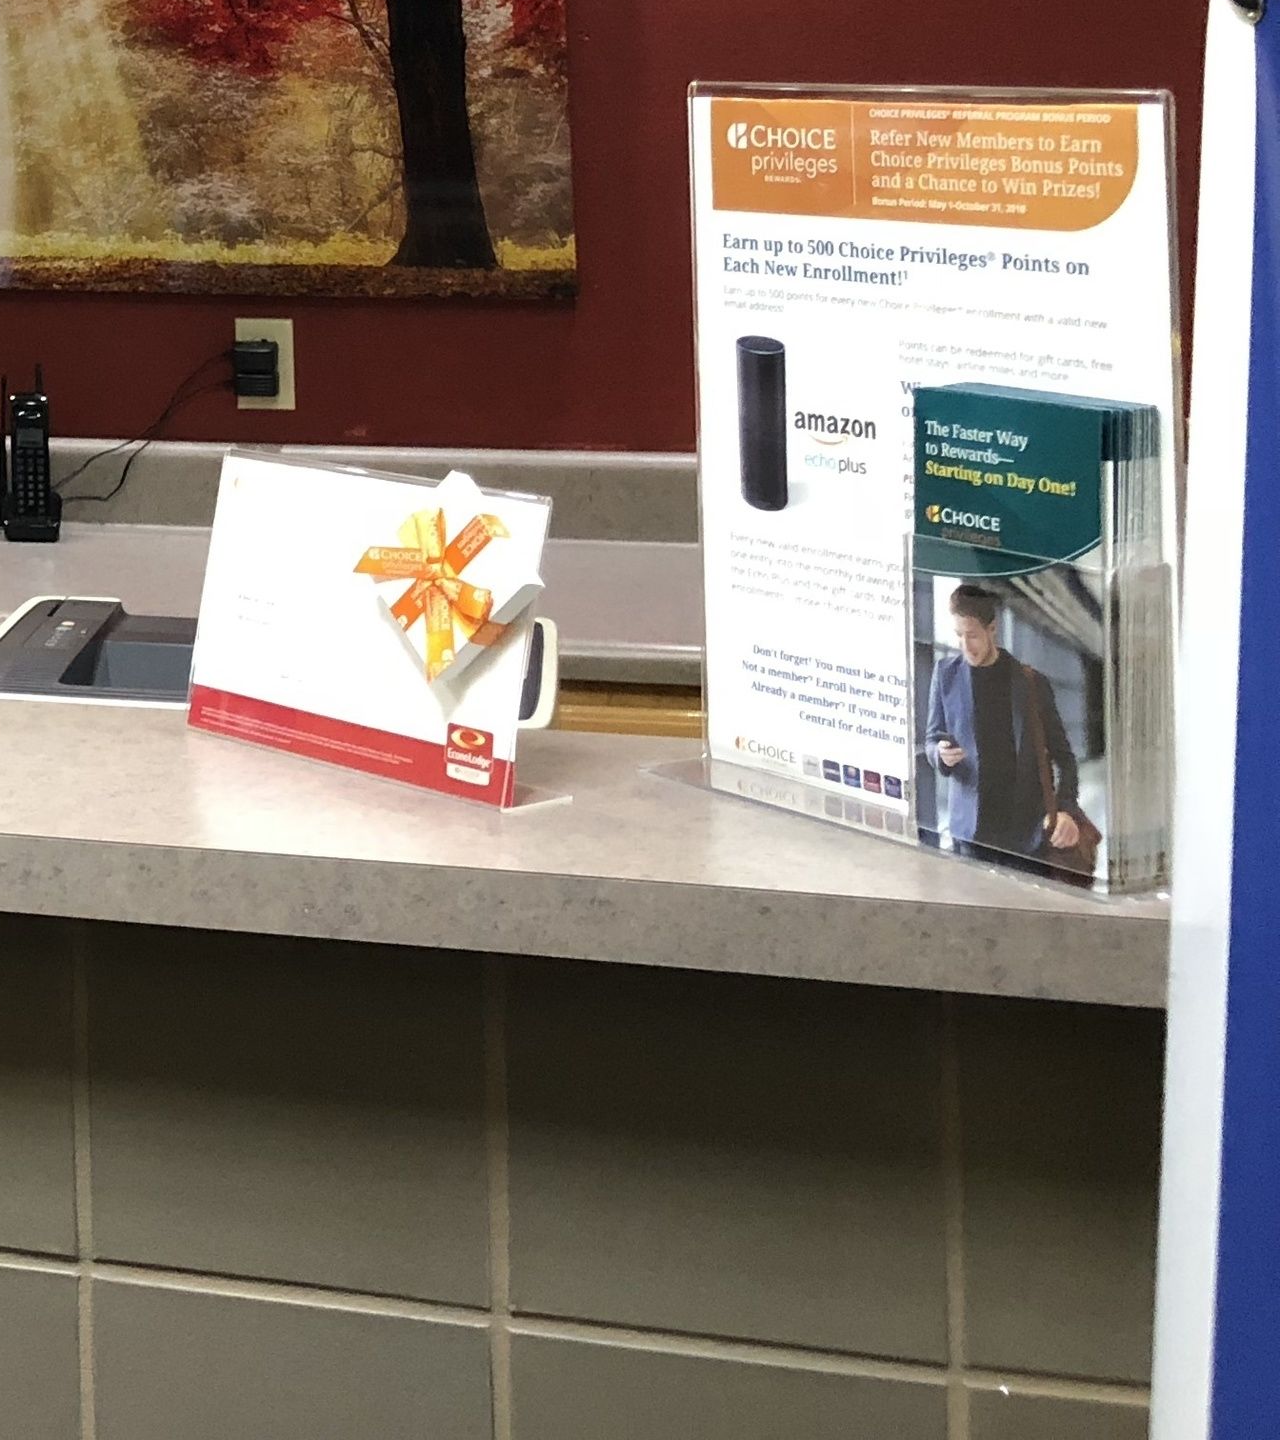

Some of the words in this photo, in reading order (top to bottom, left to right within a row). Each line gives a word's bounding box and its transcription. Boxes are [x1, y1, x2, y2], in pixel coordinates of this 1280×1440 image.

[1076, 113, 1111, 124] PERIOD
[750, 124, 837, 150] CHOICE
[870, 129, 912, 147] Refer
[916, 130, 951, 148] New
[956, 132, 1034, 151] Members
[1039, 135, 1055, 152] to
[1060, 135, 1102, 153] Earn
[751, 151, 838, 178] privileges
[870, 150, 923, 169] Choice
[926, 152, 1006, 175] Privileges
[1011, 156, 1063, 175] Bonus
[1067, 158, 1124, 177] Points
[871, 172, 901, 188] and
[905, 176, 914, 189] a
[918, 174, 977, 193] Chance
[981, 177, 997, 194] to
[1002, 178, 1037, 196] Win
[1042, 180, 1101, 199] Prizes!
[871, 196, 897, 207] Bonus
[723, 233, 758, 251] Earn
[763, 239, 783, 257] up
[788, 240, 803, 254] to
[807, 239, 834, 256] 500
[839, 241, 894, 260] Choice
[1002, 253, 1060, 273] Points
[1066, 261, 1089, 276] on
[723, 257, 760, 274] Each
[764, 260, 798, 277] New
[1091, 359, 1113, 371] free
[794, 411, 877, 440] amazon
[925, 420, 950, 438] The
[952, 423, 993, 443] Faster
[997, 430, 1028, 452] Way
[925, 442, 938, 455] to
[804, 453, 836, 469] echo
[838, 456, 867, 475] plus
[925, 461, 983, 486] Starting
[984, 470, 1004, 487] on
[1007, 473, 1035, 494] Day
[1038, 477, 1077, 498] One!
[941, 508, 1001, 532] CHOICE
[380, 550, 423, 561] CHOICE
[753, 644, 778, 659] Don't
[780, 650, 813, 667] forget!
[815, 659, 834, 672] You
[836, 665, 861, 677] must
[863, 668, 876, 680] be
[878, 674, 885, 682] a
[742, 660, 758, 673] Not
[760, 665, 766, 673] a
[768, 666, 813, 684] member?
[816, 677, 847, 693] Enroll
[751, 681, 788, 699] Already
[790, 690, 796, 699] a
[798, 692, 845, 710] member?
[848, 703, 857, 714] If
[858, 708, 878, 721] you
[880, 713, 897, 723] are
[799, 710, 836, 728] Central
[838, 719, 853, 732] for
[856, 724, 890, 742] details
[892, 734, 905, 745] on
[747, 740, 796, 763] CHOICE
